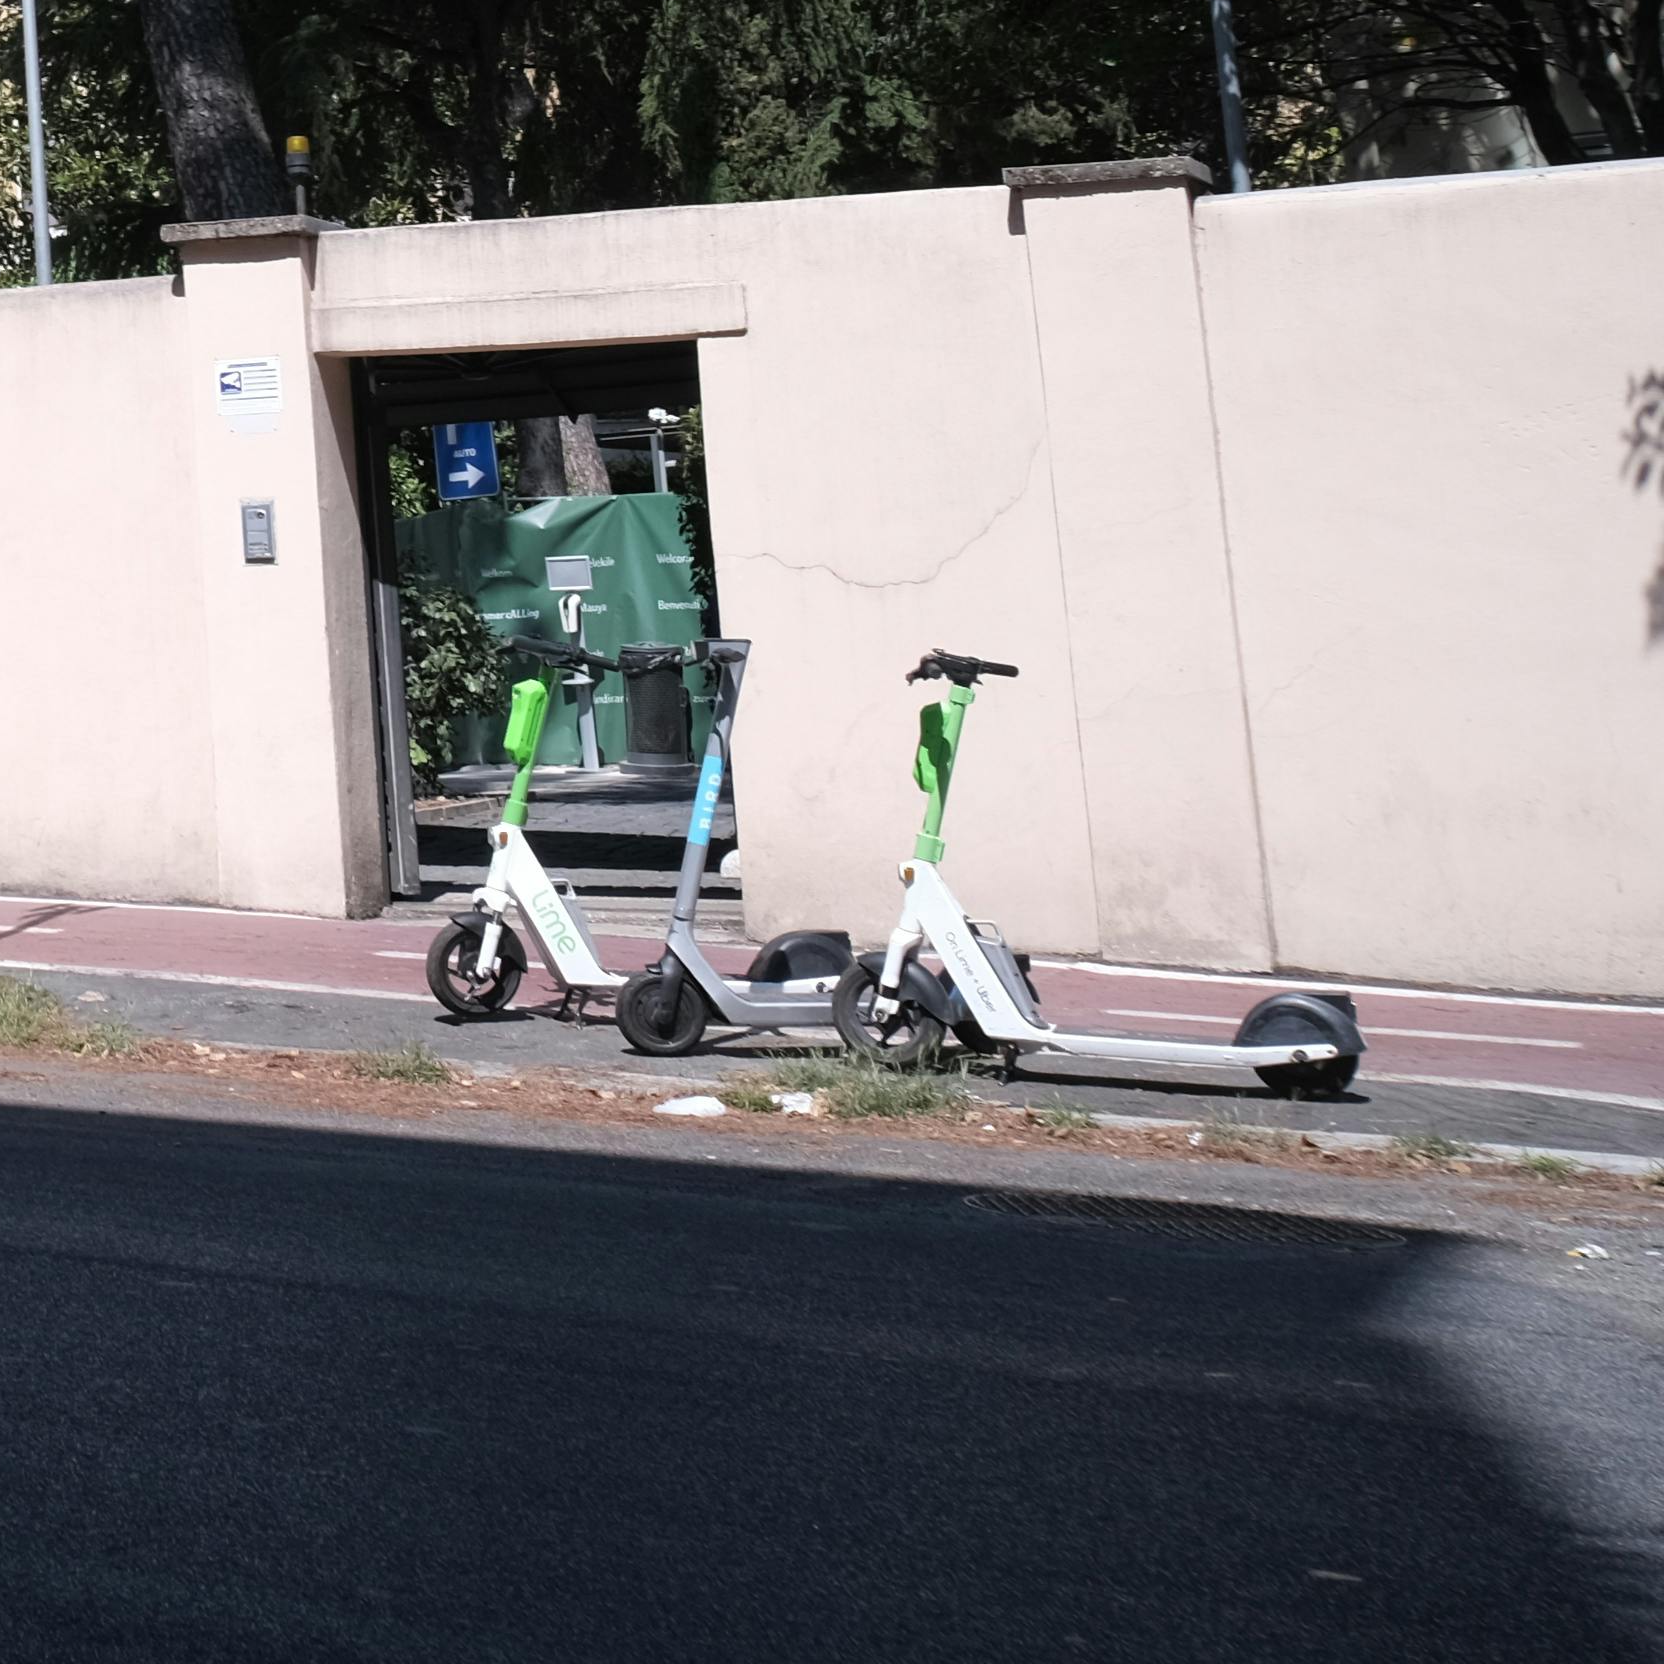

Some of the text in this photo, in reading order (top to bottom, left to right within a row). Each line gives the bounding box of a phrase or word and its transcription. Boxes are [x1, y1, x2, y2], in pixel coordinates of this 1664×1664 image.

[698, 773, 722, 829] BIRD
[532, 889, 576, 955] Lime
[976, 986, 997, 1012] Uber
